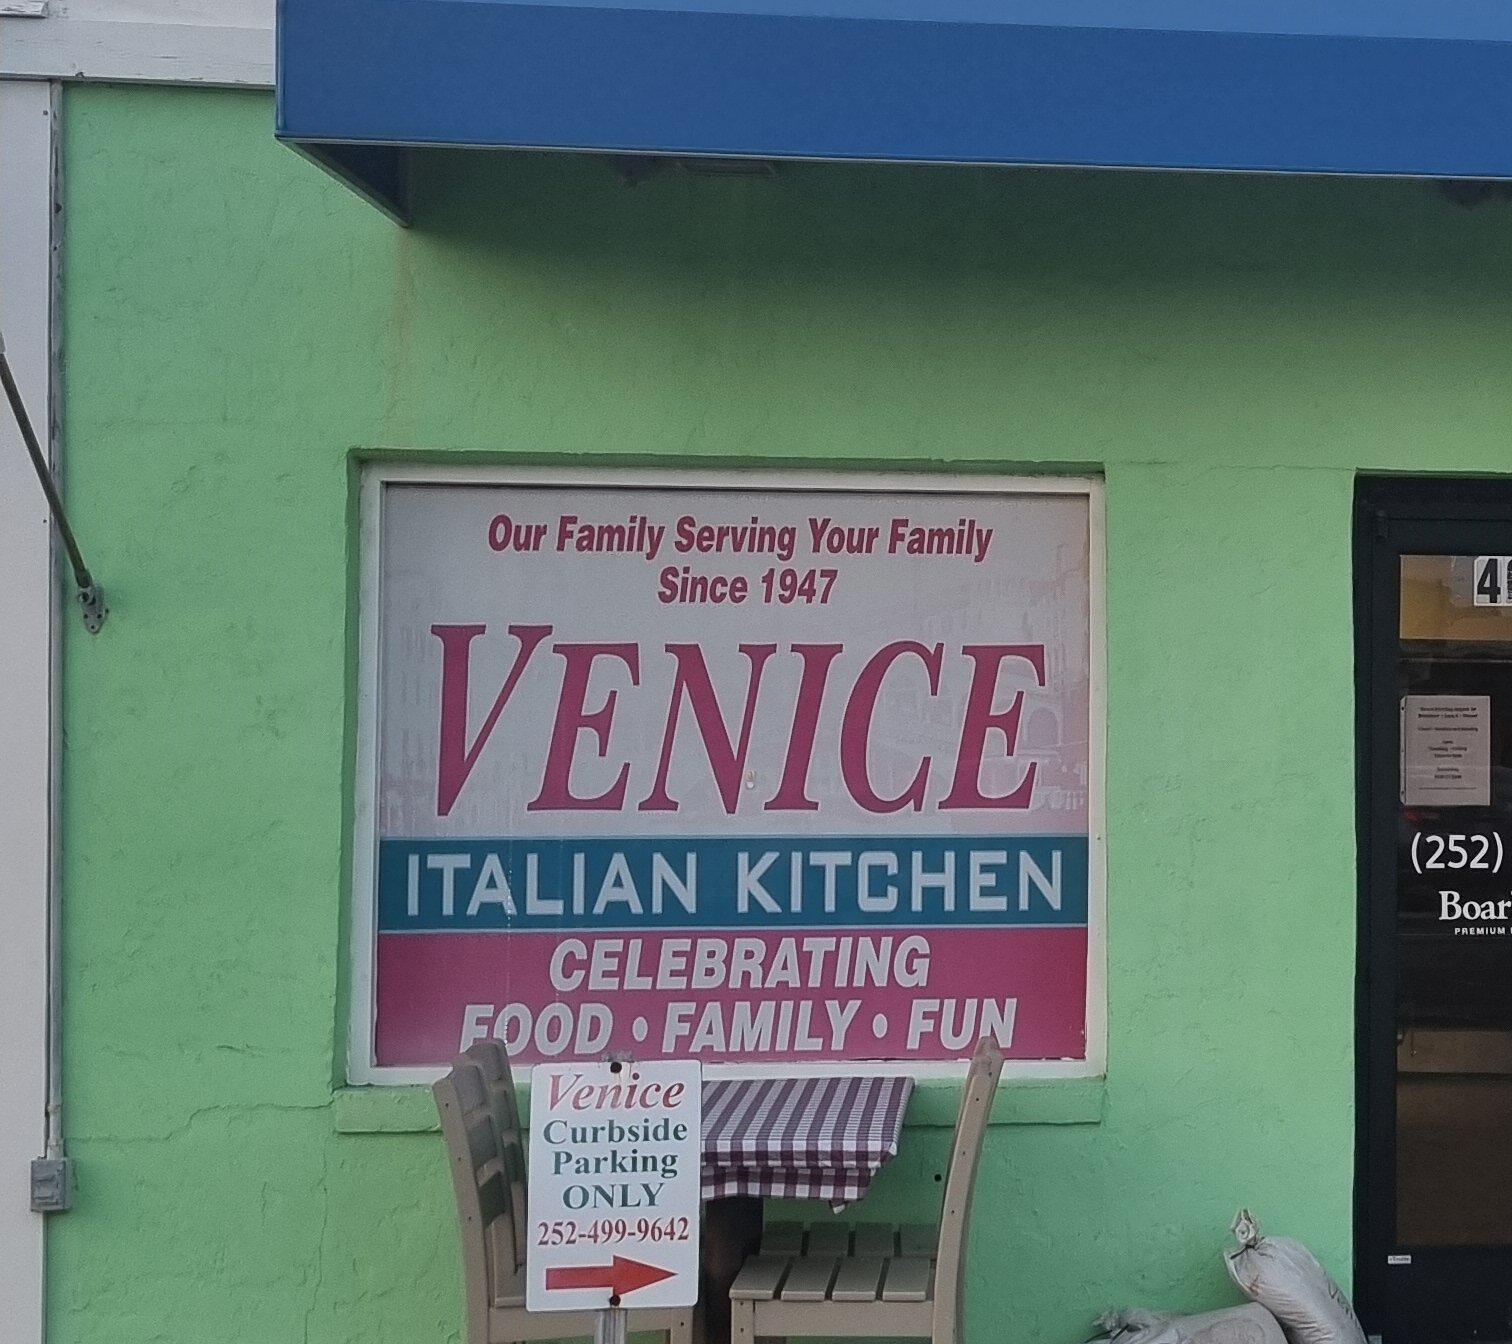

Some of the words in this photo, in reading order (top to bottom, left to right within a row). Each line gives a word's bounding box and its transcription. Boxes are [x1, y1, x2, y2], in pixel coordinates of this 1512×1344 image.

[489, 515, 547, 552] Our
[557, 516, 664, 560] Family
[674, 516, 797, 560] Serving
[808, 518, 881, 555] Your
[888, 518, 993, 562] Family
[658, 567, 748, 604] Since
[760, 568, 839, 605] 1947
[430, 623, 1047, 816] VENICE
[1411, 831, 1504, 874] (252)
[407, 851, 698, 916] ITALIAN
[737, 849, 1063, 914] KITCHEN
[1454, 926, 1506, 935] PREMIUM
[549, 935, 931, 991] CELEBRATING
[459, 1002, 613, 1056] FOOD
[661, 999, 862, 1054] FAMILY
[907, 997, 1018, 1050] FUN
[549, 1072, 685, 1111] Venice
[543, 1117, 688, 1144] Curbside
[553, 1148, 679, 1179] Parking
[562, 1182, 665, 1210] ONLY
[537, 1216, 690, 1246] 252-499-9642
